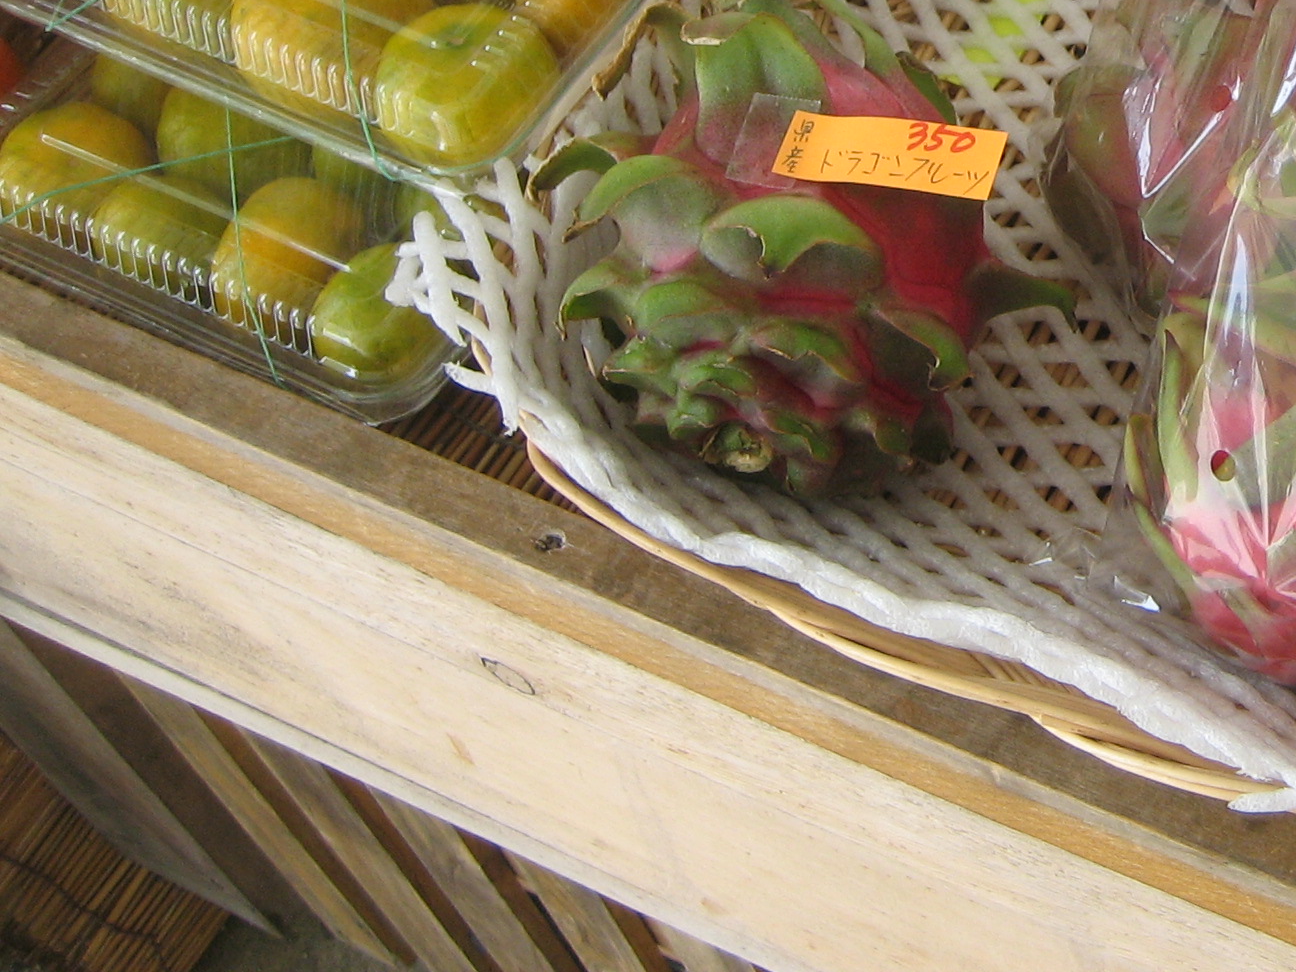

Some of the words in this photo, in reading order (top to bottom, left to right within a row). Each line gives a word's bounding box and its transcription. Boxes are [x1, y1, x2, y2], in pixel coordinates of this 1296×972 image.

[906, 121, 977, 154] 350
[820, 148, 990, 196] ドラゴンフルーツ
